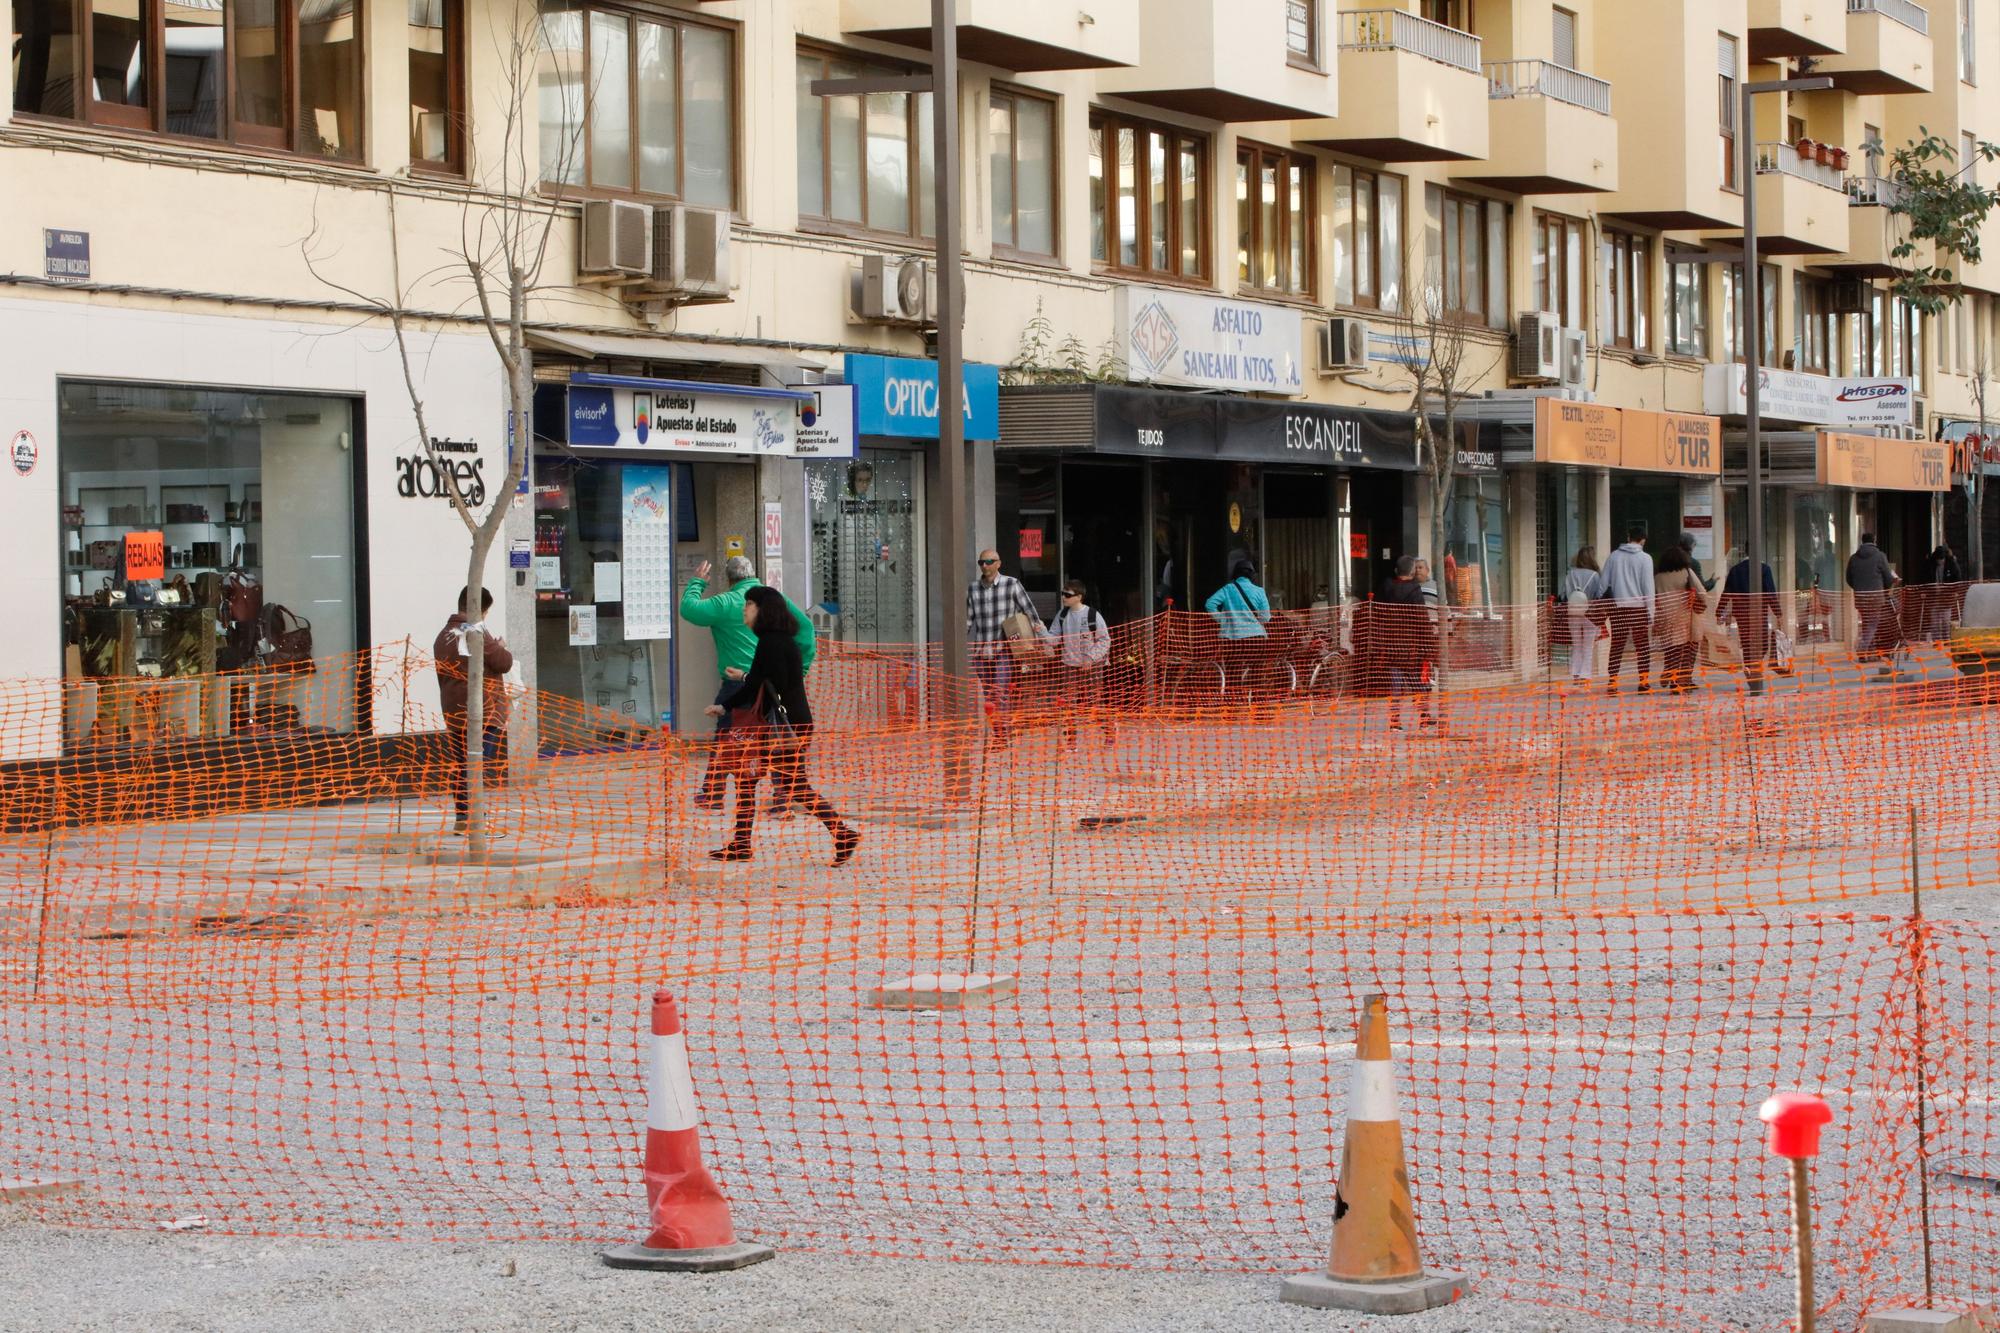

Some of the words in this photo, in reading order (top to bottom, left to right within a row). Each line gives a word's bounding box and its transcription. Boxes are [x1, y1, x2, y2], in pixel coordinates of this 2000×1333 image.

[1212, 306, 1263, 337] ASFALTO
[1238, 338, 1243, 351] Y
[575, 405, 602, 420] eivisort
[690, 397, 696, 414] y
[1876, 401, 1907, 410] Asesores
[1561, 405, 1584, 423] TEXTIL
[1585, 409, 1605, 425] HOGAR
[656, 415, 694, 433] Apuestas
[695, 417, 708, 433] del
[709, 418, 737, 434] Estado
[1677, 419, 1710, 437] ALMACENES
[796, 437, 828, 445] Apuestas
[828, 436, 839, 444] del
[1138, 429, 1164, 446] TEJIDOS
[1286, 416, 1362, 453] ESCANDELL
[1457, 450, 1495, 466] CONFECCIONES
[1677, 436, 1711, 468] TUR
[1921, 461, 1944, 486] TUR
[766, 513, 781, 546] 50
[127, 542, 163, 568] REBAJAS
